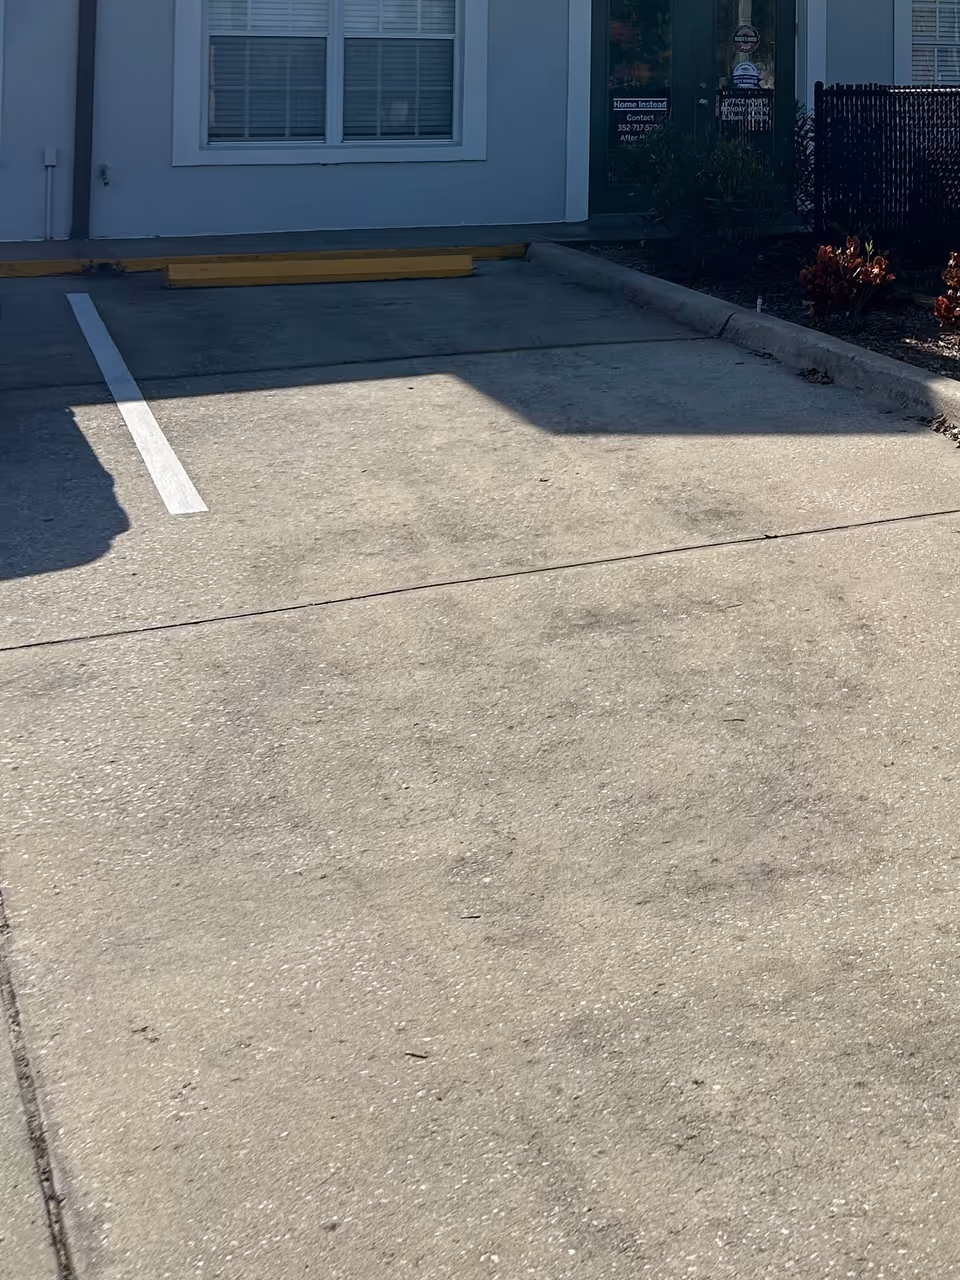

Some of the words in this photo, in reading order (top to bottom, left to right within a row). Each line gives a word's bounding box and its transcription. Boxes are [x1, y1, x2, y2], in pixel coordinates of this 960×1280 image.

[613, 100, 637, 108] Home
[638, 100, 667, 108] Instead
[626, 113, 655, 121] Contact
